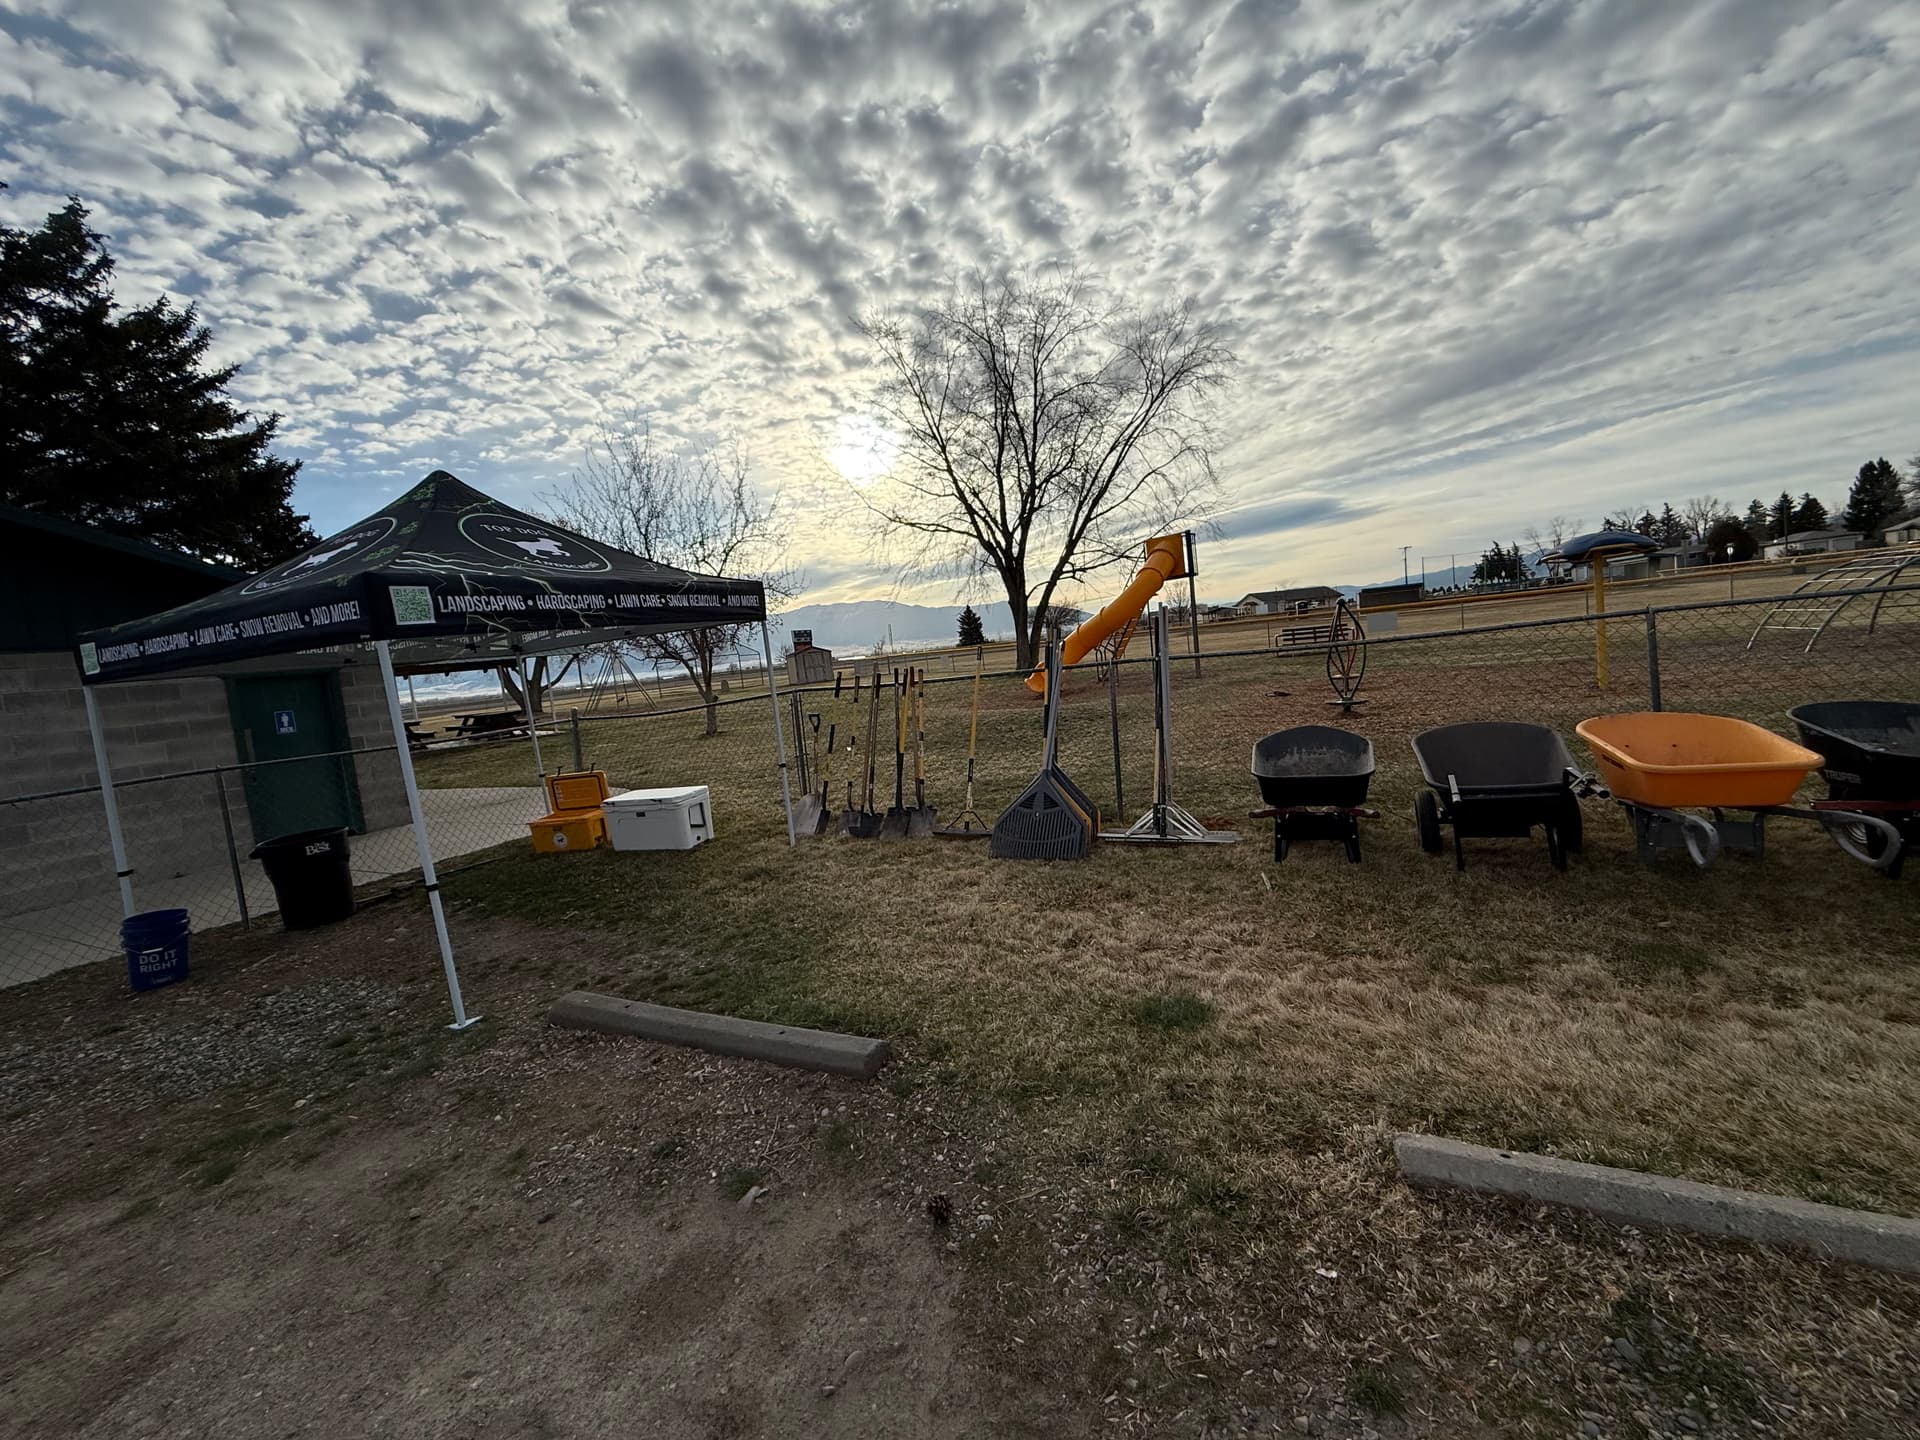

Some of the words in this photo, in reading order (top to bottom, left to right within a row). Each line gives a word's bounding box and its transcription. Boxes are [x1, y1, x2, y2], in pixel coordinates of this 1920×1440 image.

[479, 523, 512, 533] TOP
[514, 526, 549, 537] DOG
[438, 594, 526, 614] LANDSCAPING
[536, 594, 606, 611] HARDSCAPING
[614, 594, 639, 609] LAWN
[639, 594, 661, 608] CARE
[666, 595, 688, 608] SNOW
[688, 594, 721, 608] REMOVAL
[727, 595, 740, 607] AND
[740, 595, 760, 608] MORE!
[97, 641, 140, 664] LANDSCAPING
[143, 631, 190, 655] HARDSCAPING
[195, 627, 215, 646] LAWN
[215, 624, 236, 643] CARE
[239, 617, 264, 639] SNOW
[264, 610, 305, 635] REMOVAL
[311, 604, 330, 628] AND
[330, 600, 361, 623] MORE!
[138, 953, 160, 965] DO
[163, 949, 177, 961] IT
[139, 958, 178, 975] RIGHT
